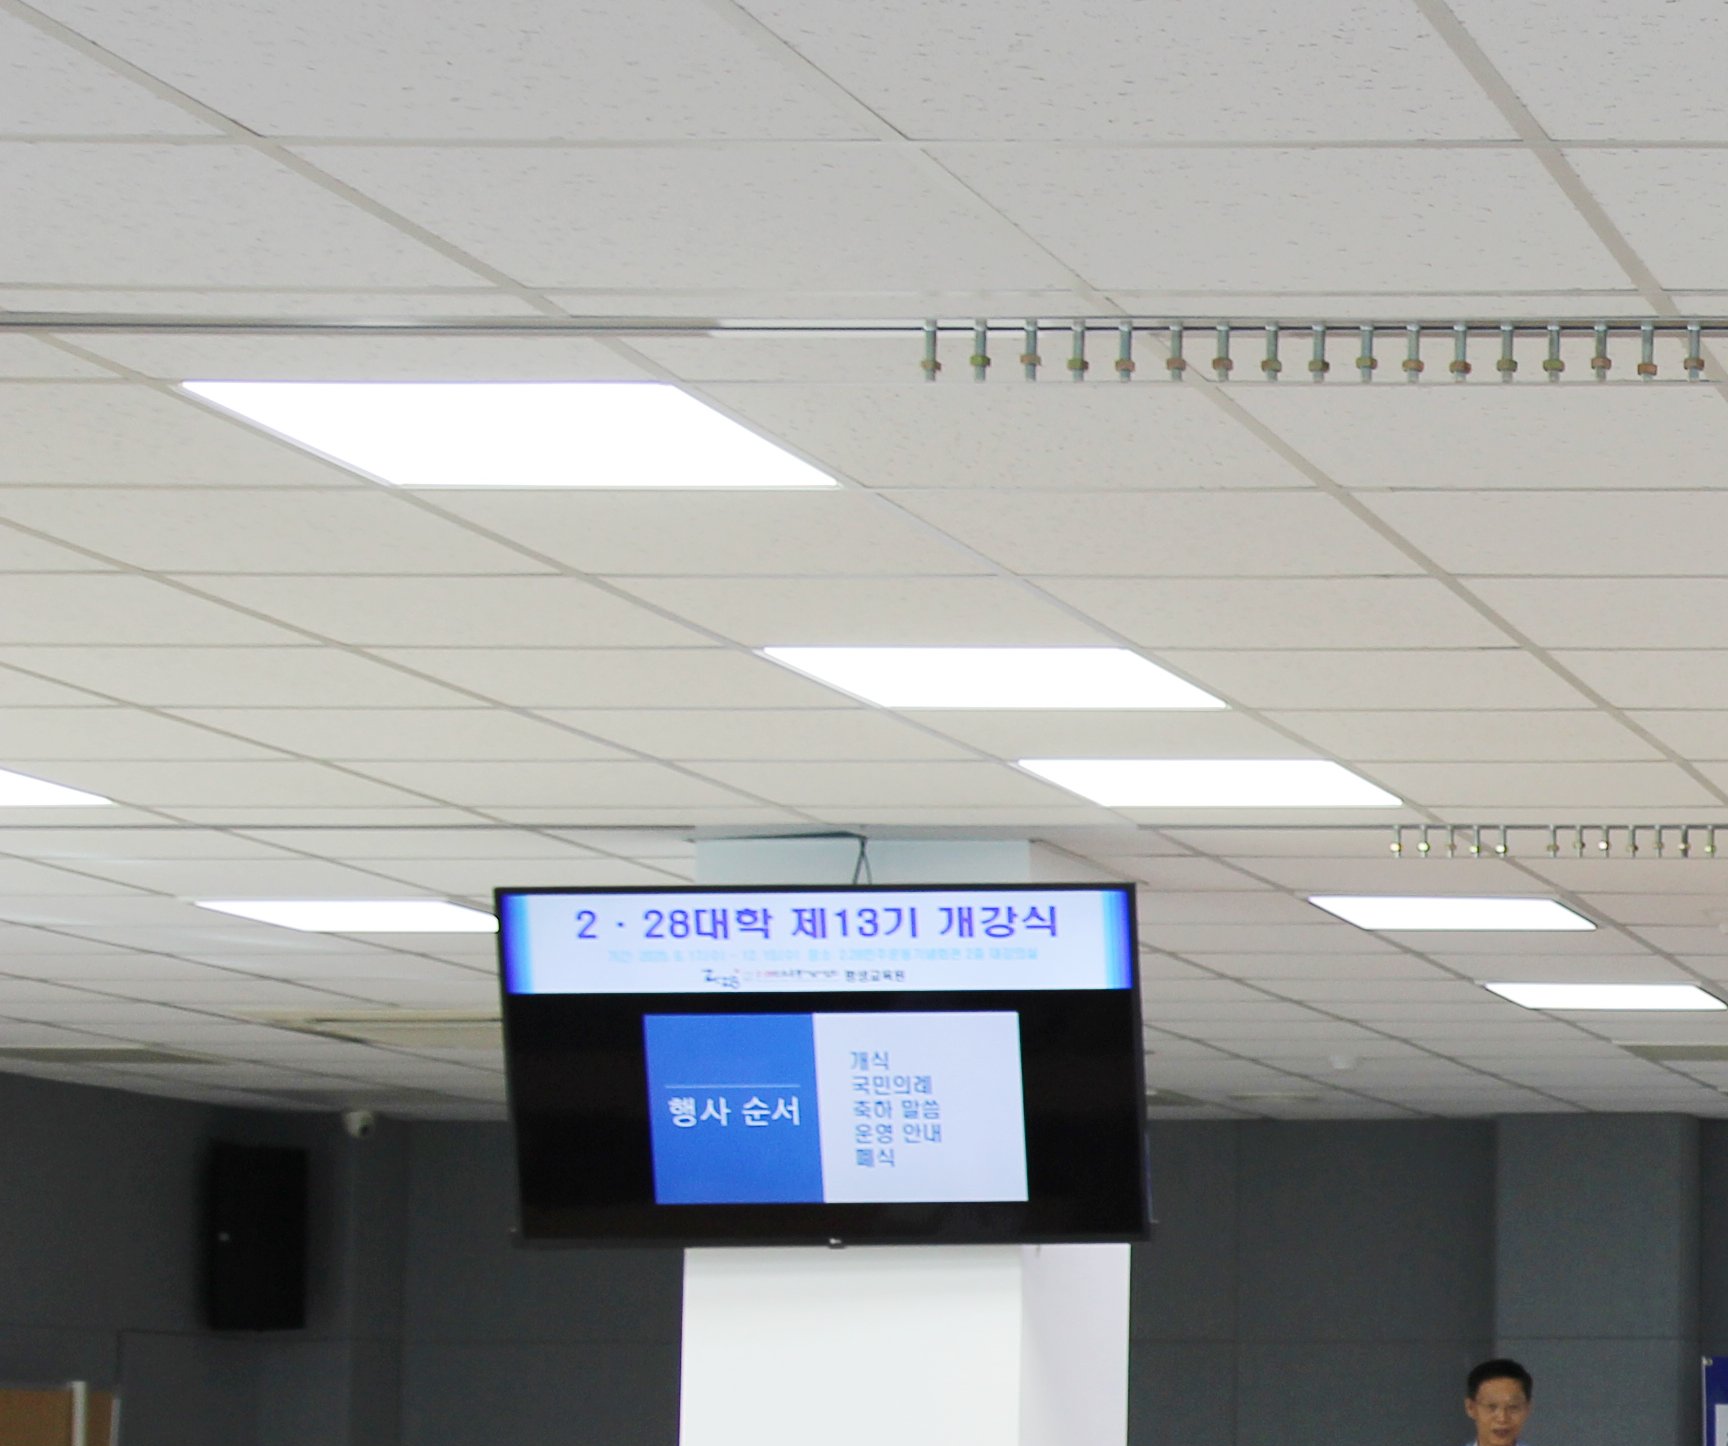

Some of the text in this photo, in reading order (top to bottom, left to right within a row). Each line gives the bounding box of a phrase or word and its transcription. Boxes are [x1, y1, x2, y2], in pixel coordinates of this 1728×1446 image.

[575, 909, 598, 940] 2
[642, 907, 774, 940] 28대학
[790, 906, 918, 940] 제13기
[937, 904, 1058, 939] 개강식
[850, 1051, 889, 1071] 개식
[666, 1095, 802, 1130] 행사 순서
